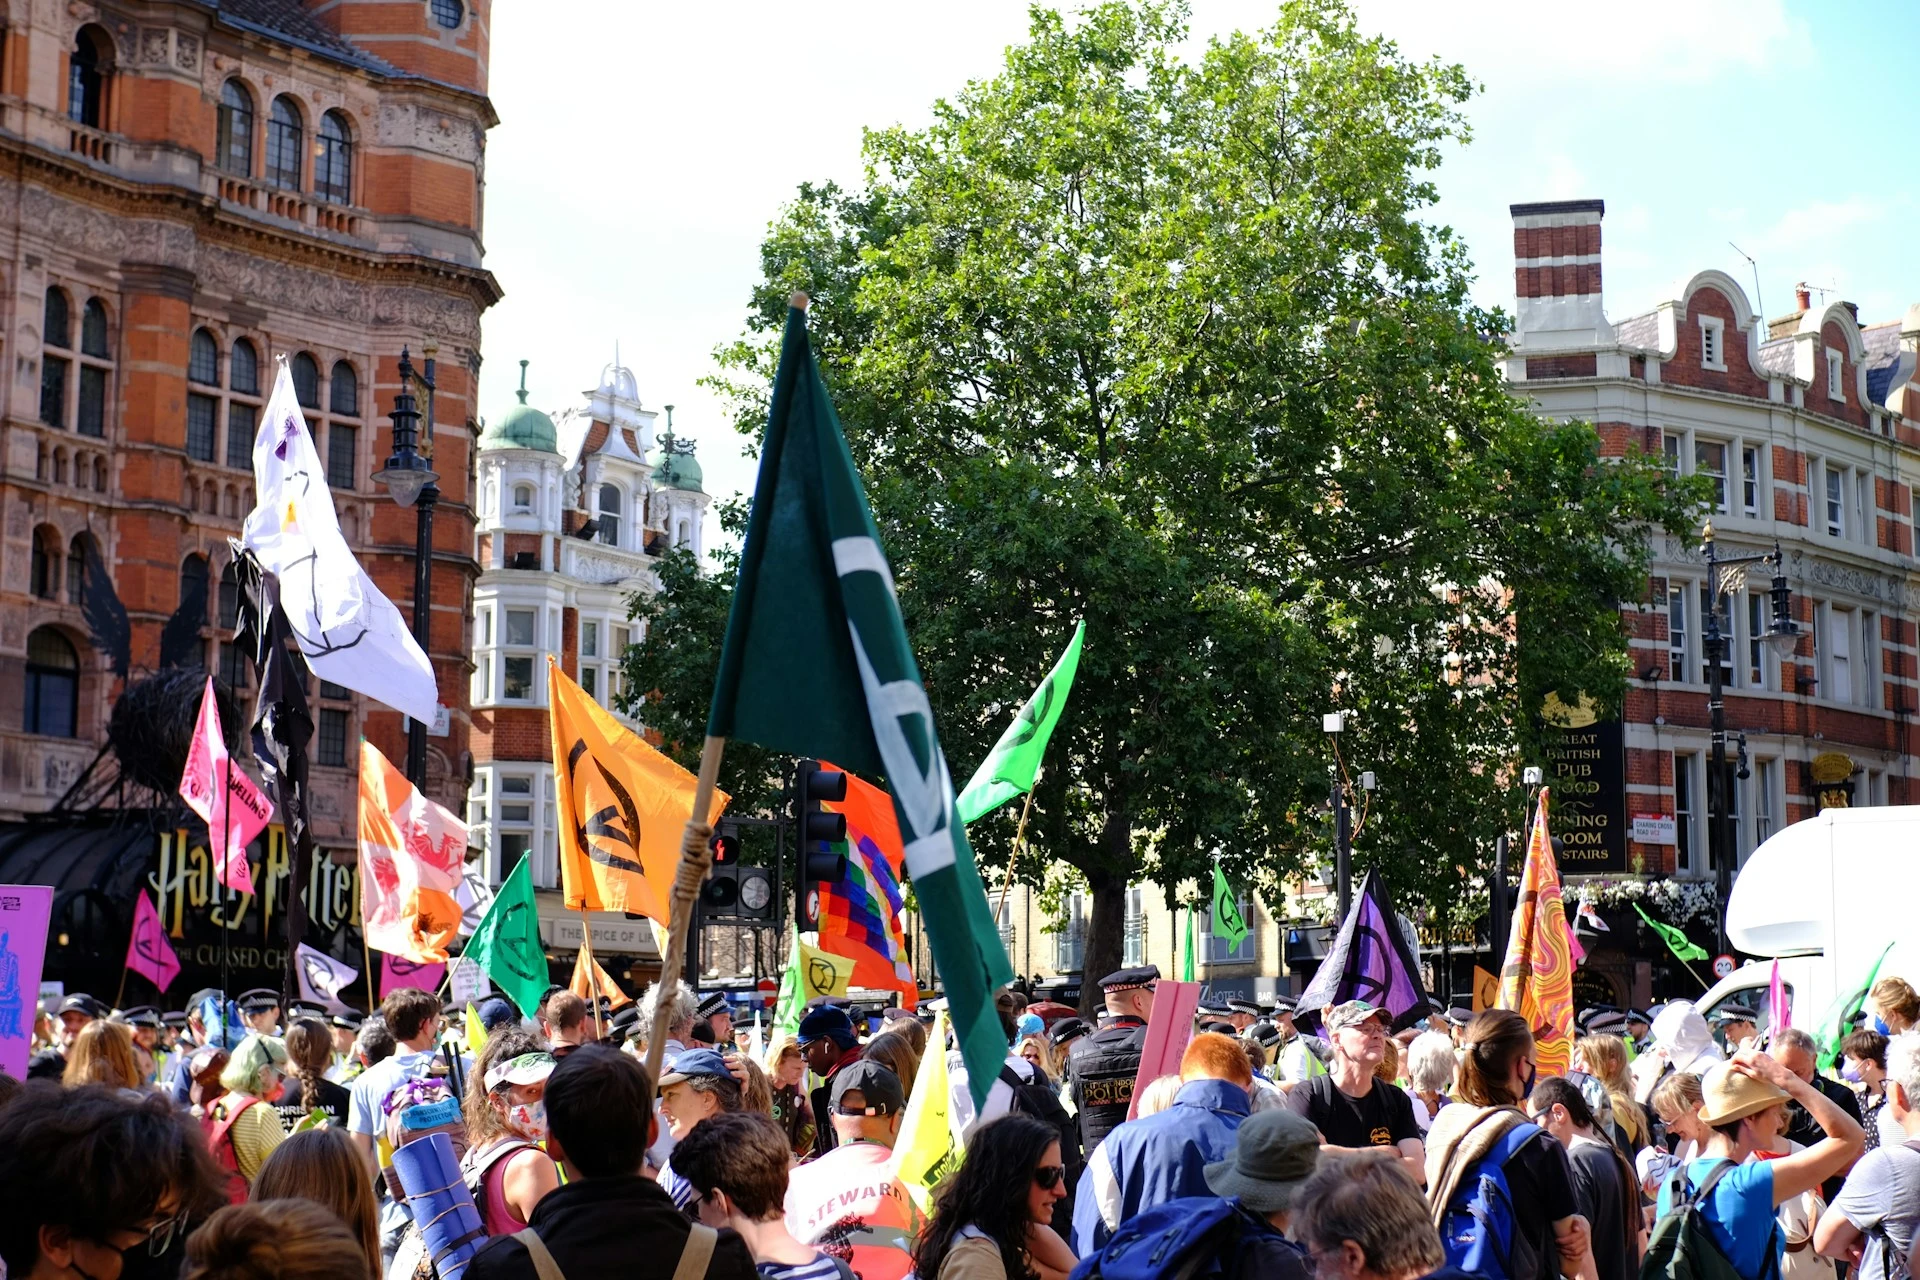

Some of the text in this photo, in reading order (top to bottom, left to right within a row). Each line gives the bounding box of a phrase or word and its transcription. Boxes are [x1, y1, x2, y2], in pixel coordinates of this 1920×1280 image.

[1560, 734, 1598, 745] REAT
[1561, 781, 1600, 794] OOD
[1636, 821, 1673, 830] CHARING CROSS
[1562, 832, 1602, 845] OOM
[561, 928, 654, 943] THE PICE OF LIF
[1211, 990, 1244, 1002] HOTELS
[1257, 991, 1273, 1002] BAR
[274, 1104, 335, 1116] CHRISAN
